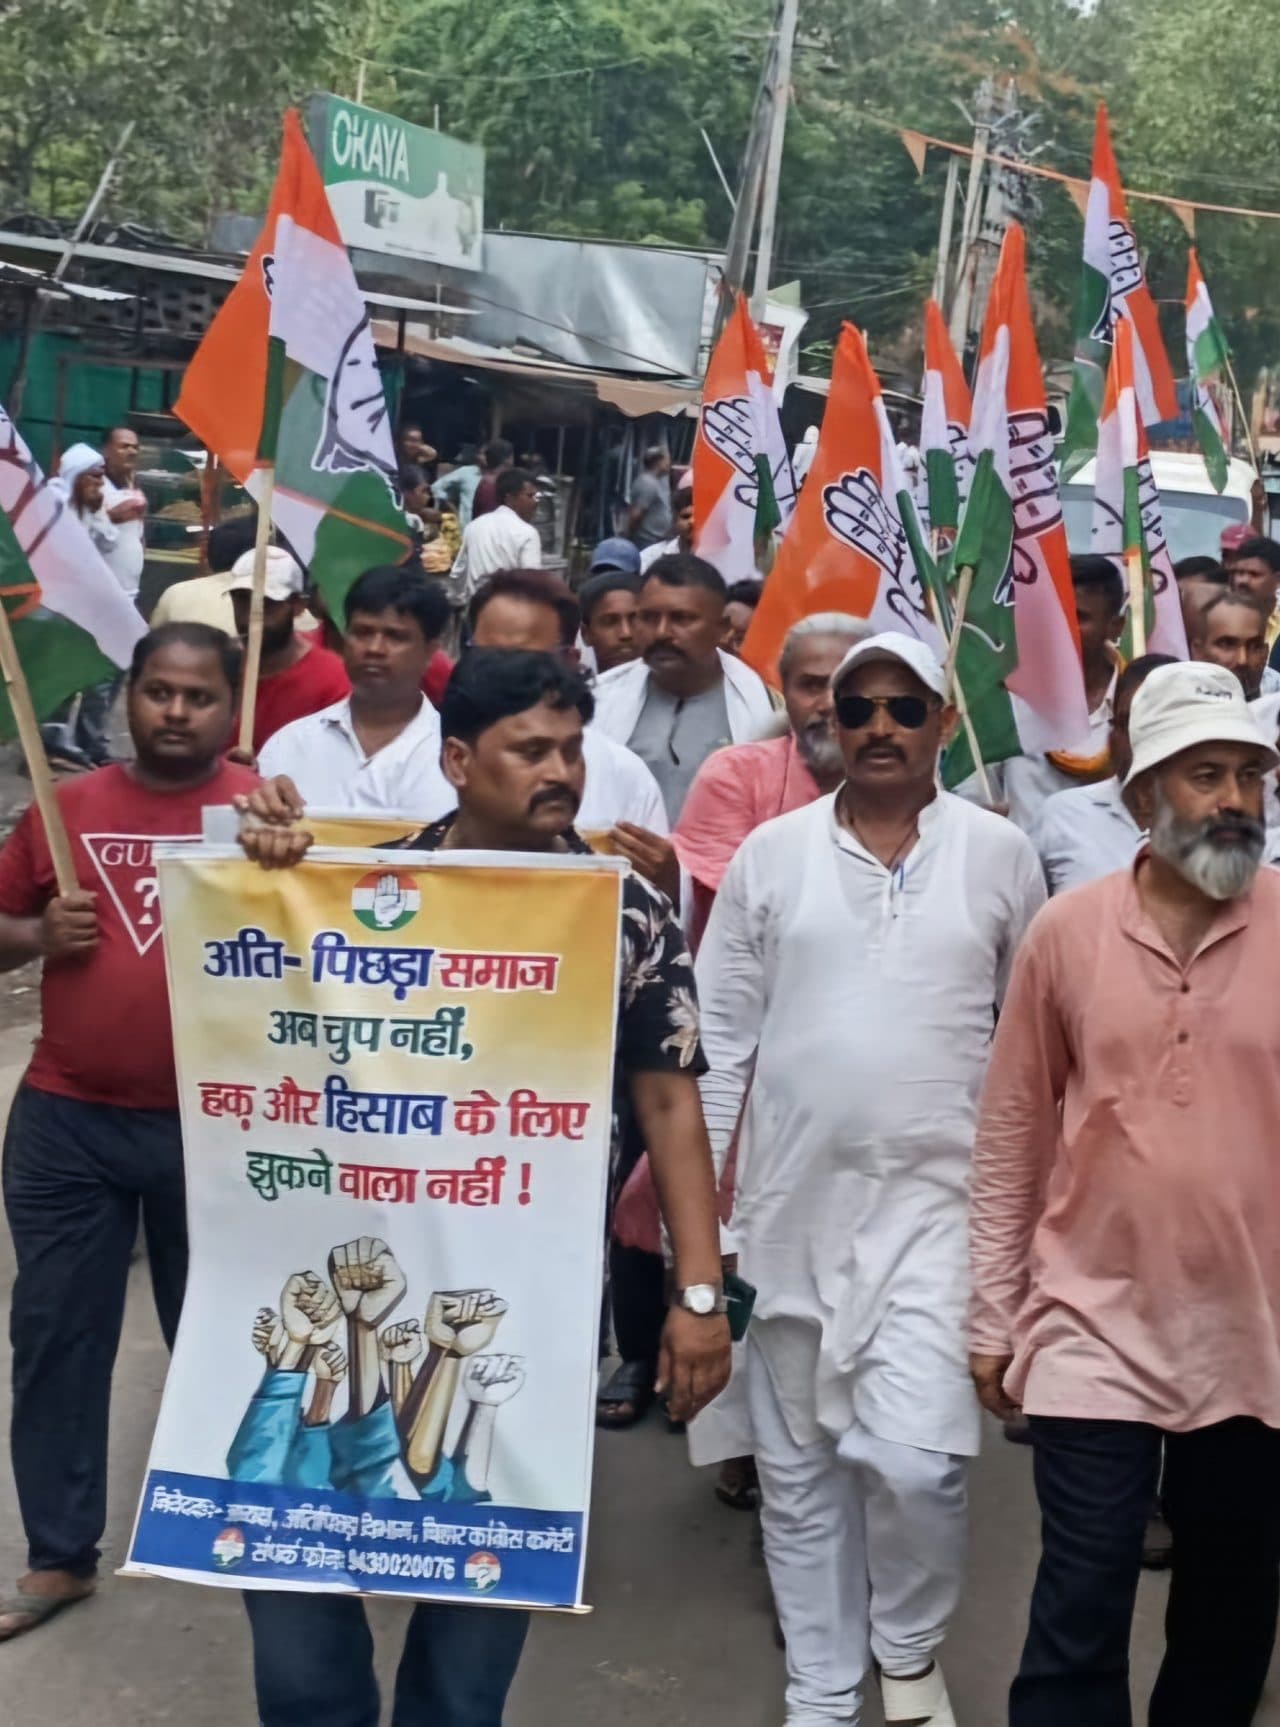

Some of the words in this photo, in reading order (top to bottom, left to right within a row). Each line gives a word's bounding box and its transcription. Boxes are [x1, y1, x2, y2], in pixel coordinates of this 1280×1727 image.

[332, 109, 410, 184] OKAYA
[100, 842, 156, 867] GU
[203, 928, 302, 979] अति-
[311, 932, 434, 1000] पिछड़ा
[439, 952, 559, 993] समाज
[268, 1009, 317, 1048] अब
[322, 1013, 385, 1064] चुप
[389, 1006, 474, 1061] नहीं,
[197, 1081, 256, 1131] हक़
[262, 1076, 321, 1127] और
[324, 1075, 449, 1136] हिसाब
[453, 1090, 501, 1136] के
[507, 1089, 590, 1141] लिए
[246, 1147, 332, 1202] झुकने
[338, 1162, 420, 1205] वाला
[425, 1155, 507, 1206] नहीं
